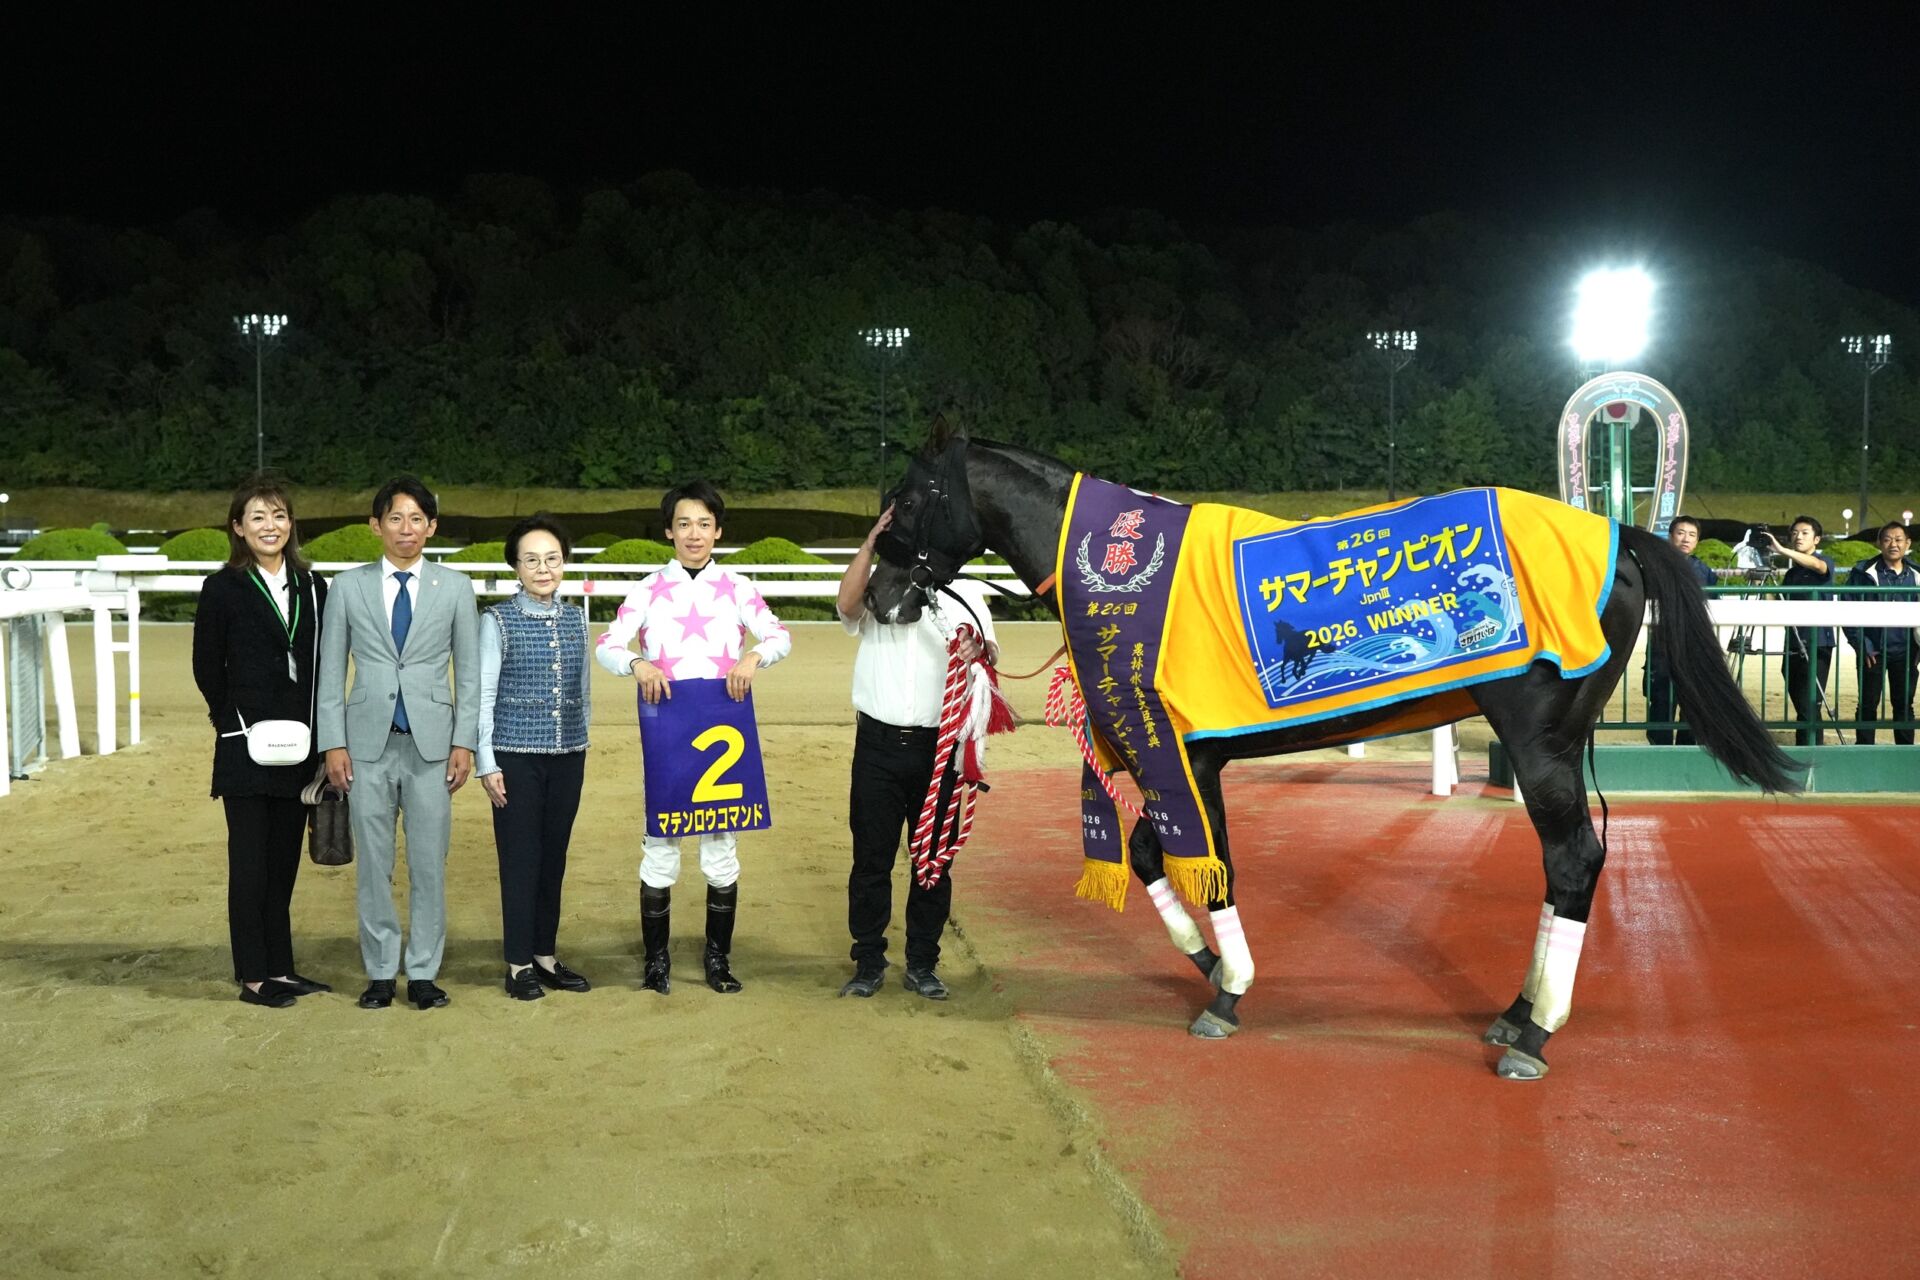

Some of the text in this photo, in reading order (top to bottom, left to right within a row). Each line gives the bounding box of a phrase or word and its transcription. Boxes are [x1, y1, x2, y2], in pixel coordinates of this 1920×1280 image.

[1101, 509, 1146, 576] 優勝
[1258, 523, 1483, 612] サマーチャンピオン
[1336, 528, 1391, 552] 第26回
[1085, 601, 1138, 617] 第26回
[1304, 620, 1358, 649] 2026
[1367, 592, 1458, 632] WINNER
[691, 724, 745, 803] 2
[657, 803, 763, 834] マテンロウコマンド
